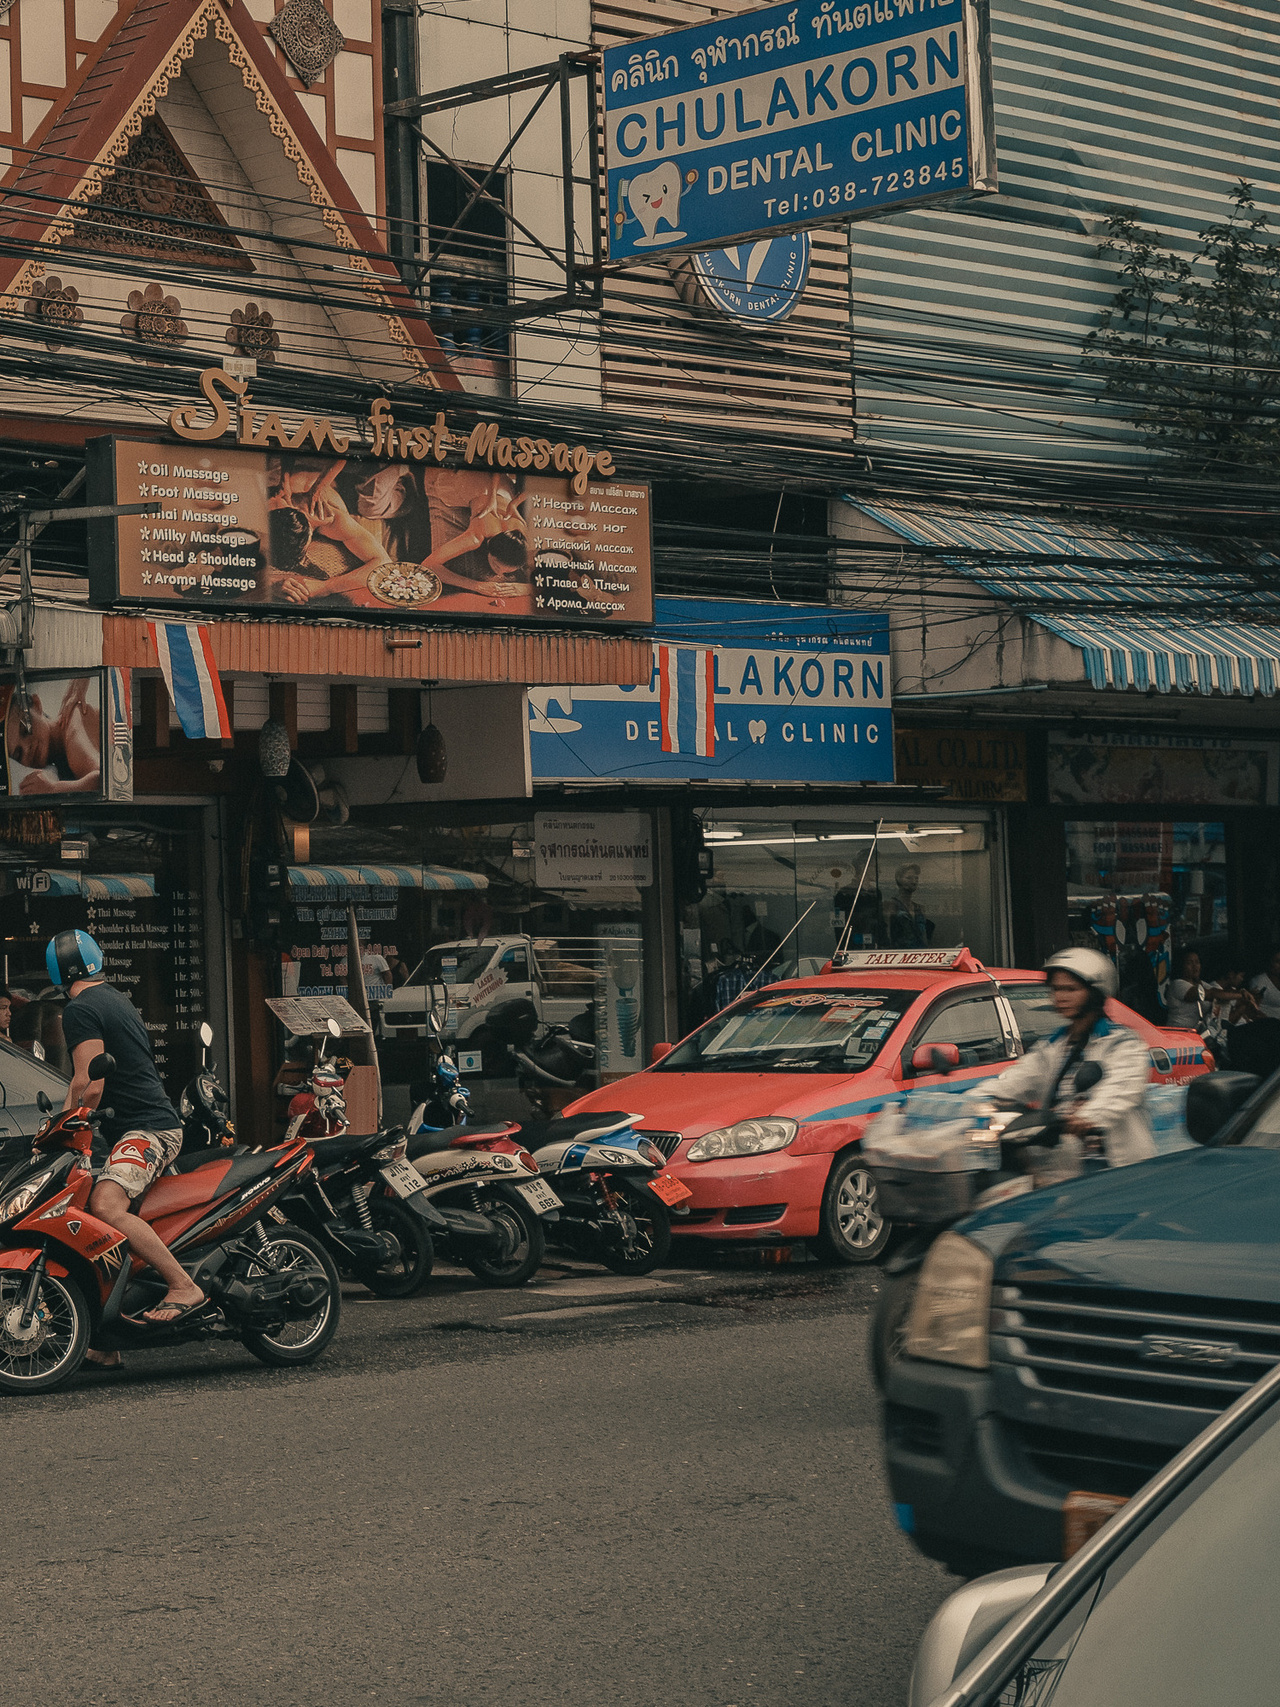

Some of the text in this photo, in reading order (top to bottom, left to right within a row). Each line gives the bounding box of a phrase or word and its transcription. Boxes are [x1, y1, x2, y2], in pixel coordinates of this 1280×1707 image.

[611, 49, 679, 92] คลินิก
[691, 9, 800, 84] จุฬากรณ์
[616, 30, 961, 158] CHULAKORN
[707, 109, 963, 195] DENTAL CLINIC
[764, 158, 964, 218] Tel:038-723845
[368, 397, 447, 462] first
[463, 421, 617, 495] Massage
[150, 463, 229, 483] Oil Massage
[151, 485, 239, 504] Foot Massage
[543, 498, 638, 516] Нефть Массаж
[182, 510, 238, 526] Massage
[543, 517, 627, 533] Массаж ног
[153, 528, 246, 547] Milky Massage
[545, 538, 634, 554] Тайский массаж
[153, 550, 257, 567] Head & Shoulders
[545, 557, 638, 574] Млечный Массаж
[154, 572, 257, 591] Aroma Massage
[546, 576, 630, 592] Глава & Плечи
[626, 720, 880, 745] DEL CLINIC
[540, 838, 650, 866] จุฬากรณ์ทันตแพทย์
[113, 907, 136, 919] Massage
[146, 923, 169, 935] Massage
[147, 940, 171, 952] Massage
[864, 952, 947, 965] TAXI METER
[472, 977, 505, 1004] WHITENING
[477, 973, 494, 990] LASER
[404, 1178, 422, 1193] 112
[538, 1196, 558, 1211] 662
[85, 1232, 113, 1253] YAMAHA
